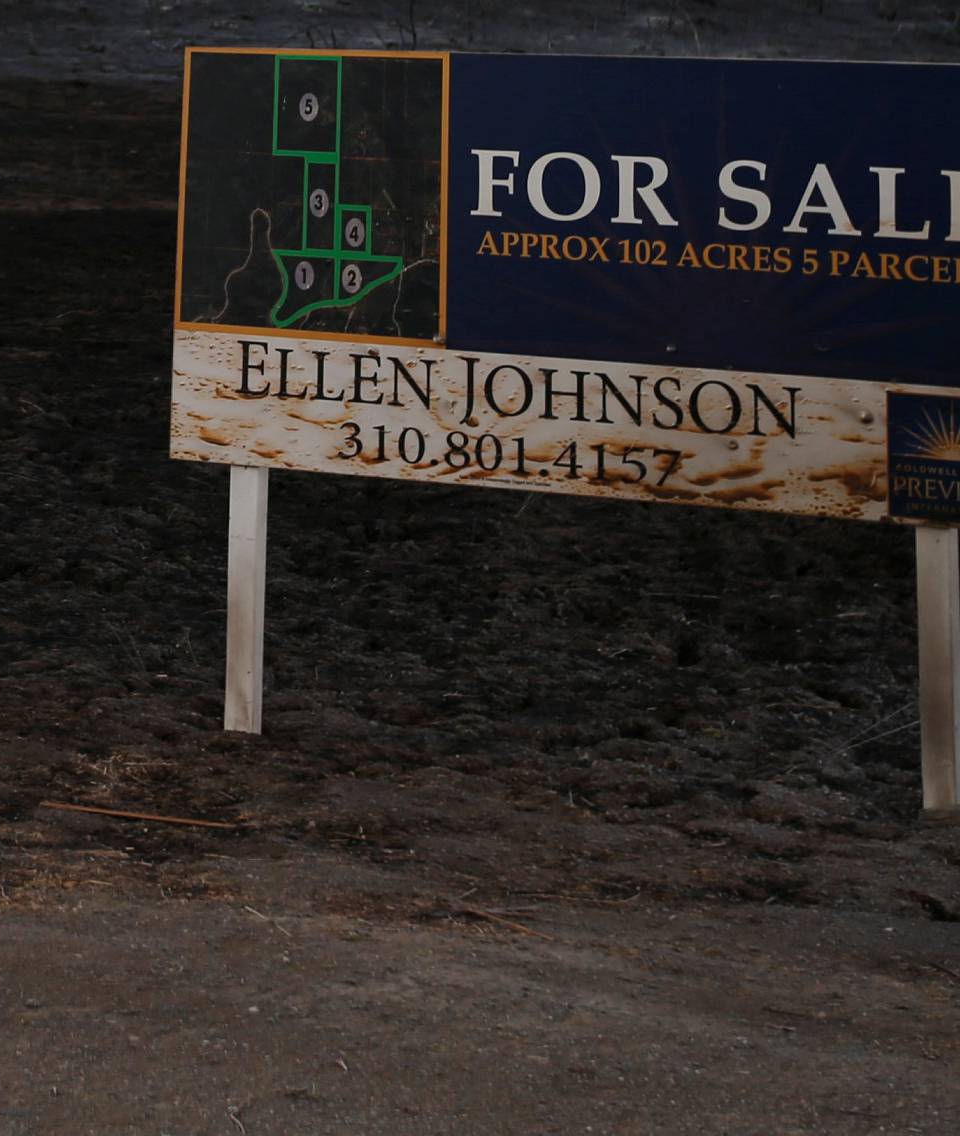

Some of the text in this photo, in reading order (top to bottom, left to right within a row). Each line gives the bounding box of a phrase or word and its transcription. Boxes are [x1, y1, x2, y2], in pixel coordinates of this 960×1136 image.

[304, 99, 313, 115] 5
[469, 148, 679, 227] FOR
[314, 194, 323, 210] 3
[349, 225, 358, 242] 4
[476, 230, 611, 263] APPROX
[618, 240, 668, 266] 102
[677, 242, 793, 275] ACRES
[801, 248, 819, 275] 5
[301, 268, 307, 284] 1
[347, 270, 356, 286] 2
[236, 339, 803, 440] ELLEN JOHNSON
[337, 421, 685, 487] 310.801.4157
